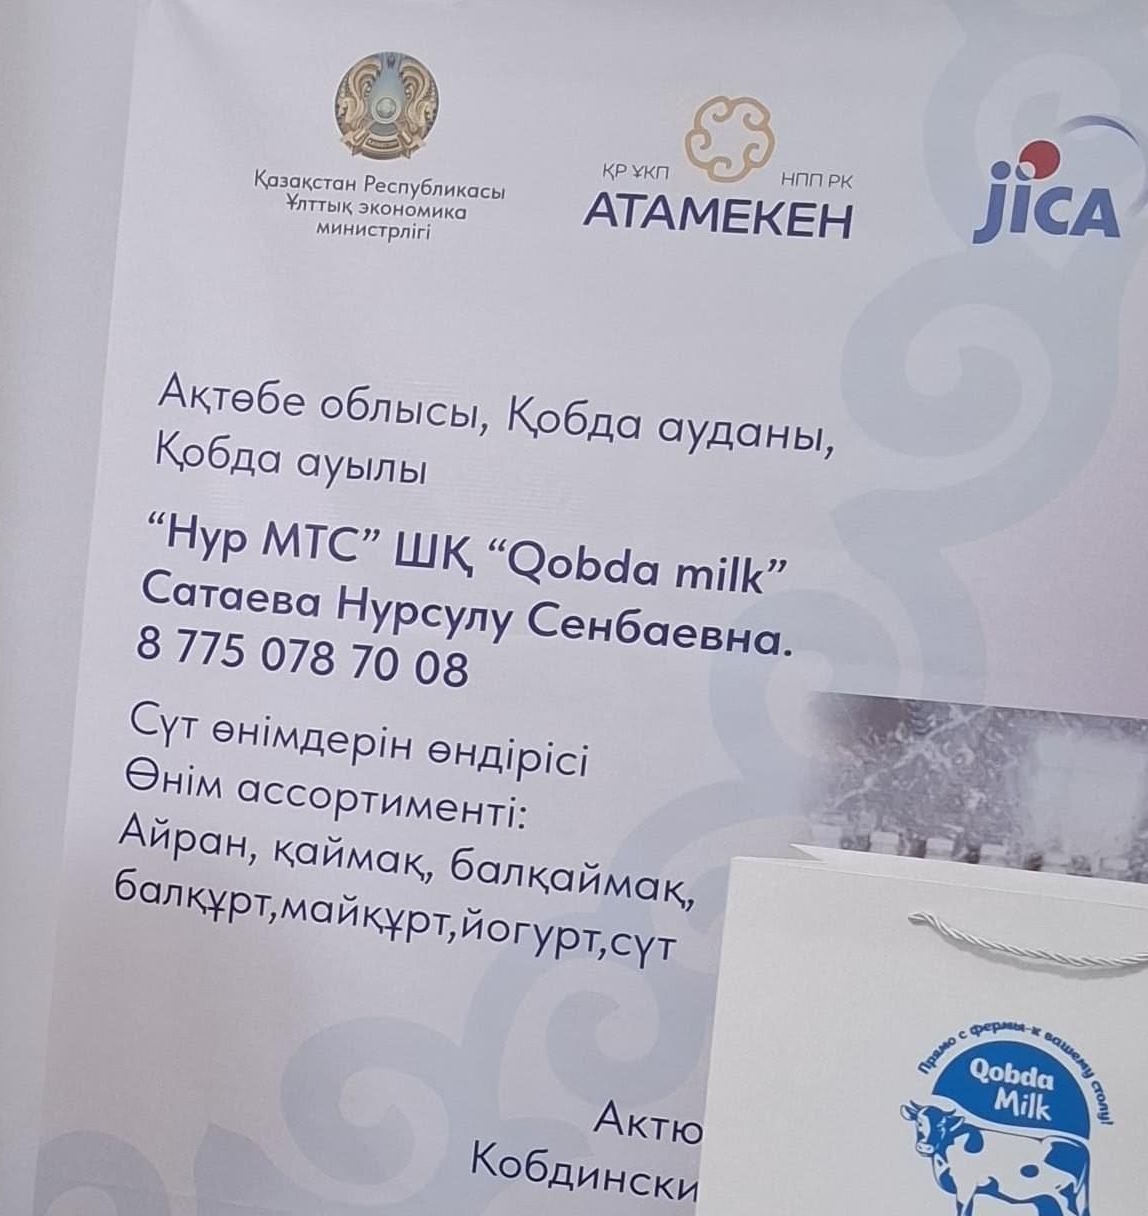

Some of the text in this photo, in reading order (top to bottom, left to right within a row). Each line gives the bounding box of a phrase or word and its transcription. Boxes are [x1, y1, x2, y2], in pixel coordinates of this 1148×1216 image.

[253, 167, 506, 204] Қазақстан Республикасы
[284, 192, 467, 222] Ұлттық экономика
[780, 170, 853, 190] НПП РК
[316, 219, 431, 243] министрлігі
[582, 191, 853, 241] АТАМЕКЕН
[158, 372, 836, 460] Ақтөбе облысы, Қобда ауданы,
[155, 429, 428, 489] Қобда ауылы
[394, 531, 474, 576] ШҚ
[142, 568, 794, 658] Сатаева Нурсулу Сенбаевна.
[135, 626, 469, 688] 8 775 078 70 08
[130, 700, 590, 780] Сүт өнімдерін өндірісі
[124, 757, 529, 829] Өнім ассортименті:
[117, 812, 697, 913] Айран, қаймақ, балқаймақ,
[917, 1037, 956, 1075] Прямо
[1044, 1032, 1094, 1079] вашему
[1091, 1080, 1114, 1125] столу!
[969, 1056, 1055, 1091] Qobda
[994, 1086, 1052, 1121] Milk
